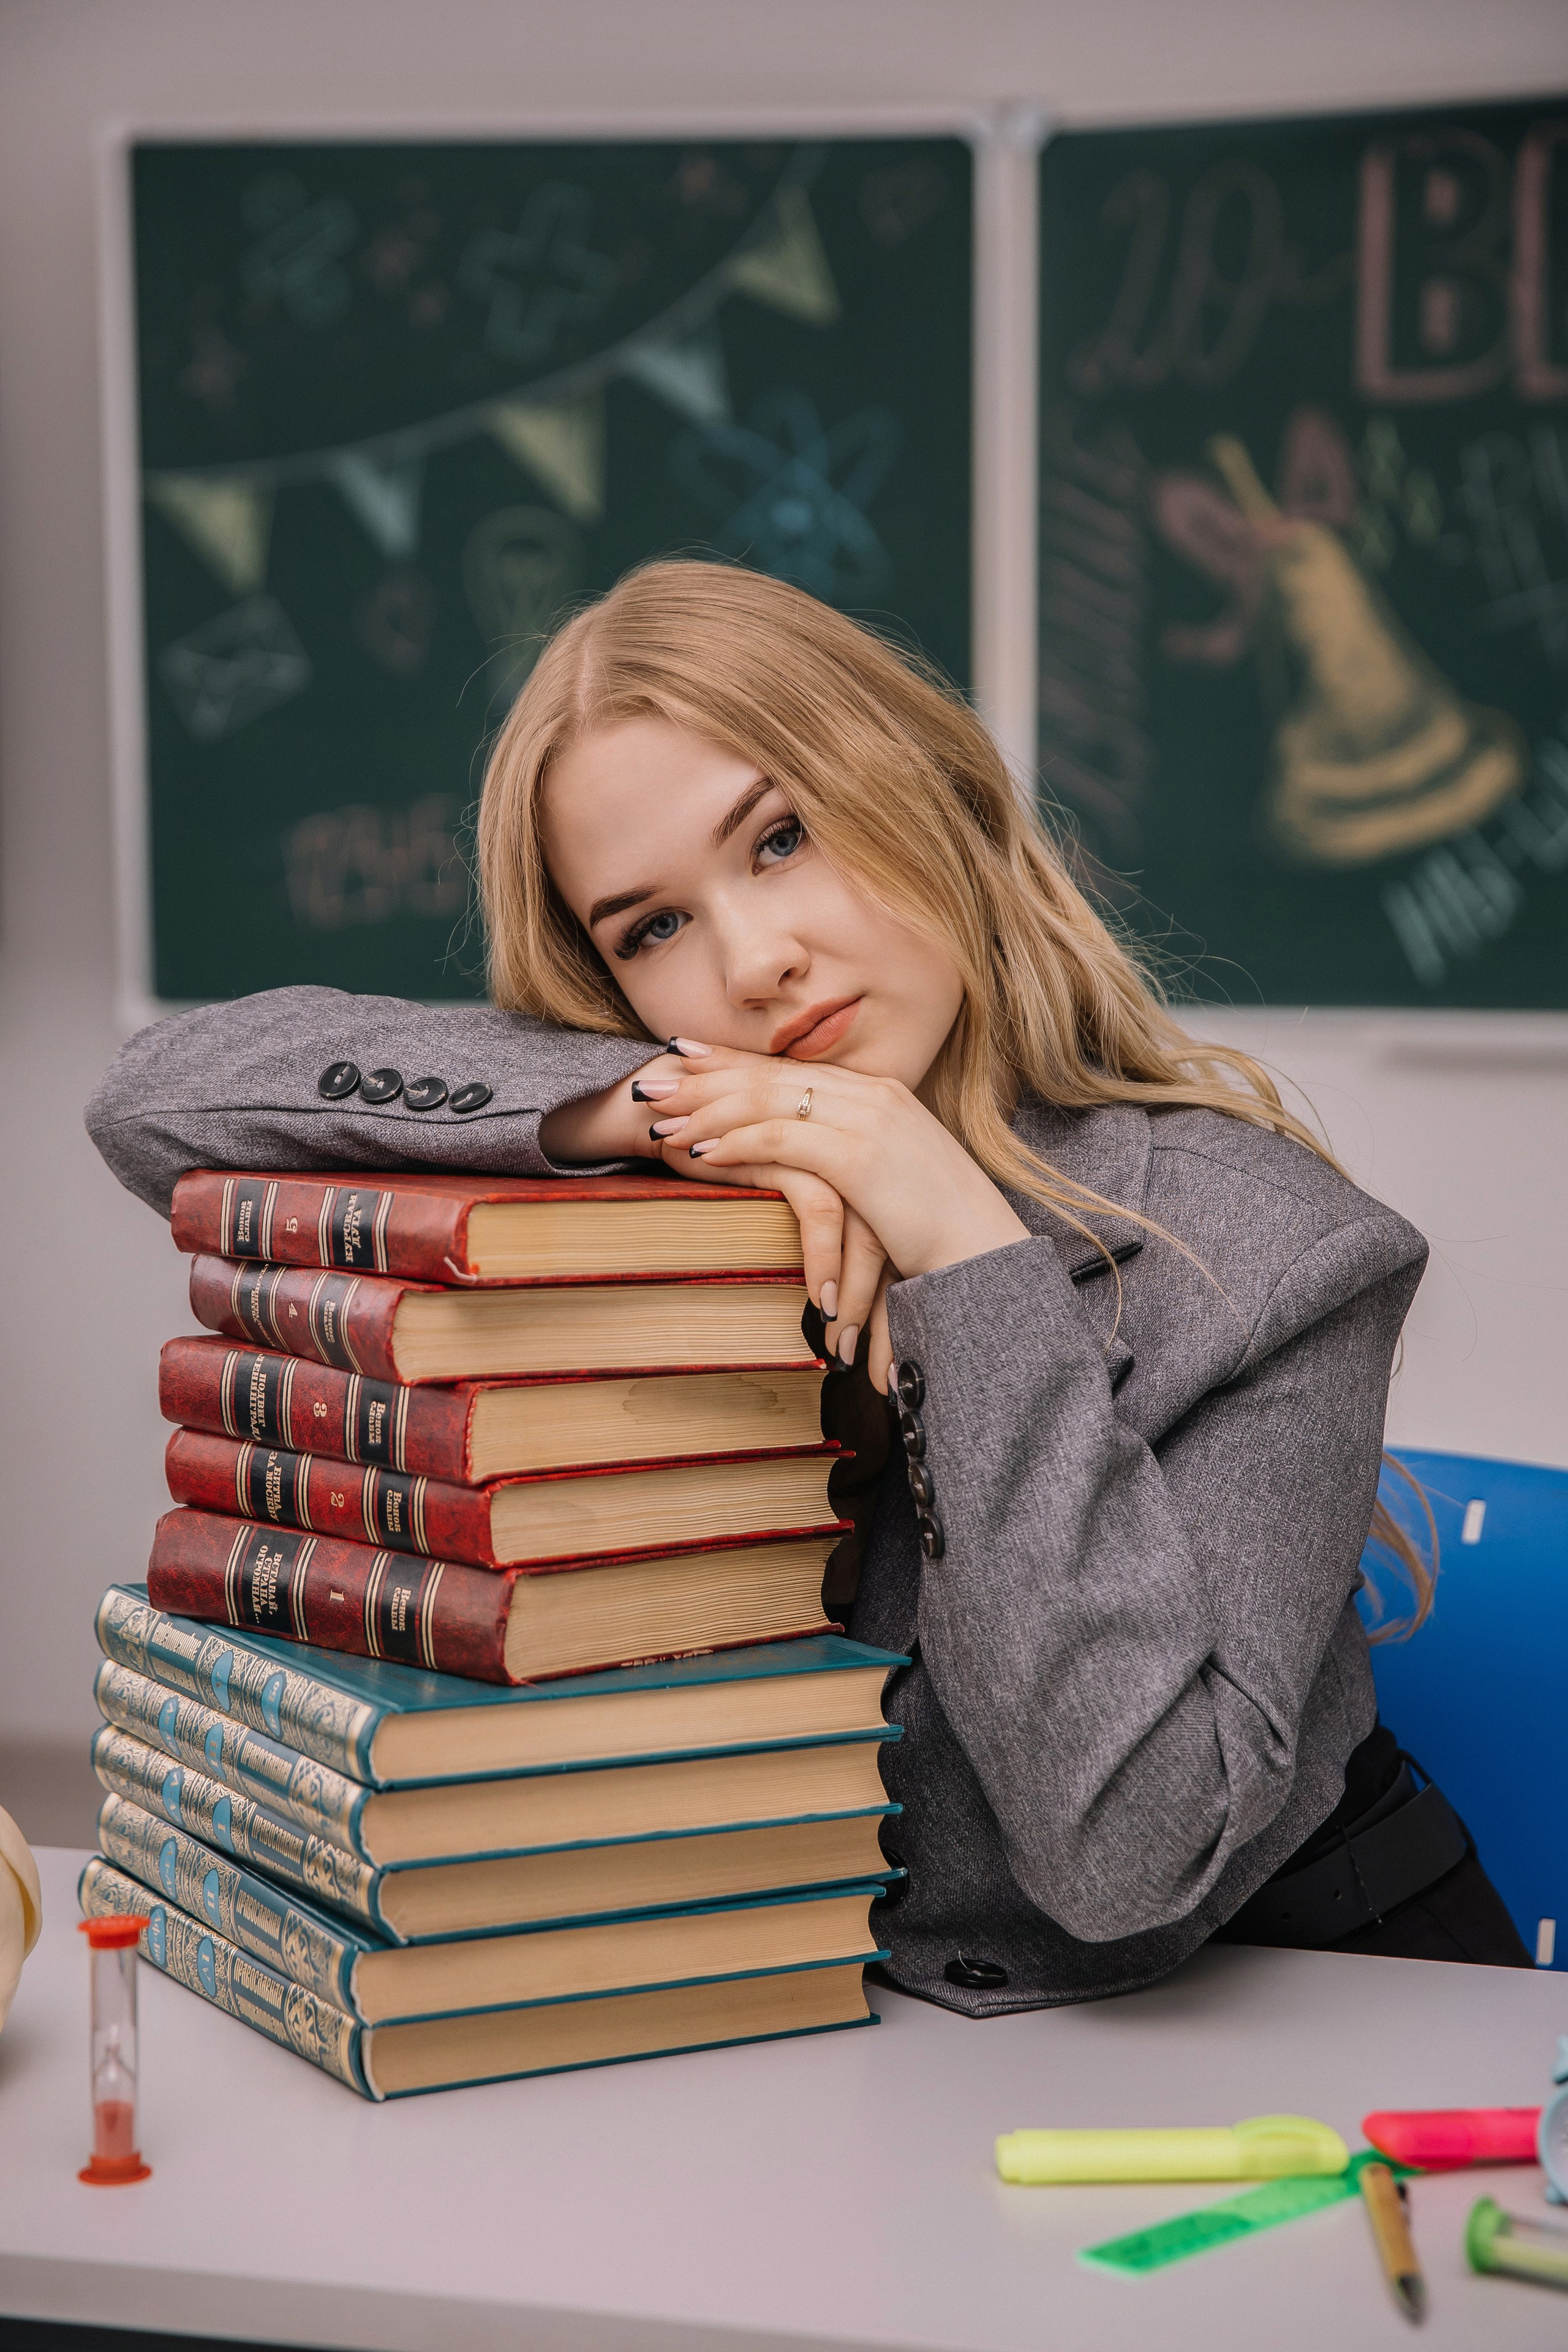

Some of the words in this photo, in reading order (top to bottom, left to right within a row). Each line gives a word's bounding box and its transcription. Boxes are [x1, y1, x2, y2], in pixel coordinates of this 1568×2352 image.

[237, 1200, 246, 1242] Венок
[285, 1216, 299, 1234] 5
[343, 1193, 357, 1262] КУРСКАЯ
[352, 1208, 361, 1248] ДУГА
[288, 1302, 298, 1317] 4
[328, 1301, 337, 1343] Венок
[250, 1353, 265, 1442] ЛЕНИНГРАДА
[257, 1373, 266, 1427] ПОДВИГ
[314, 1401, 327, 1417] 3
[375, 1402, 386, 1444] Венок
[267, 1451, 278, 1468] ЗА
[265, 1471, 279, 1521] МОСКВУ
[273, 1466, 282, 1511] БИТВА
[331, 1491, 344, 1507] 2
[393, 1491, 402, 1532] Венок
[252, 1545, 268, 1623] ОГРОМНАЯ...
[260, 1557, 272, 1606] СТРАНА
[268, 1552, 283, 1615] ВСТАВАЙ,
[330, 1588, 344, 1601] 1
[391, 1586, 401, 1630] славы
[399, 1588, 412, 1631] Венок
[209, 1739, 217, 1767] III
[207, 1889, 215, 1910] II
[202, 1952, 211, 1983] IV
